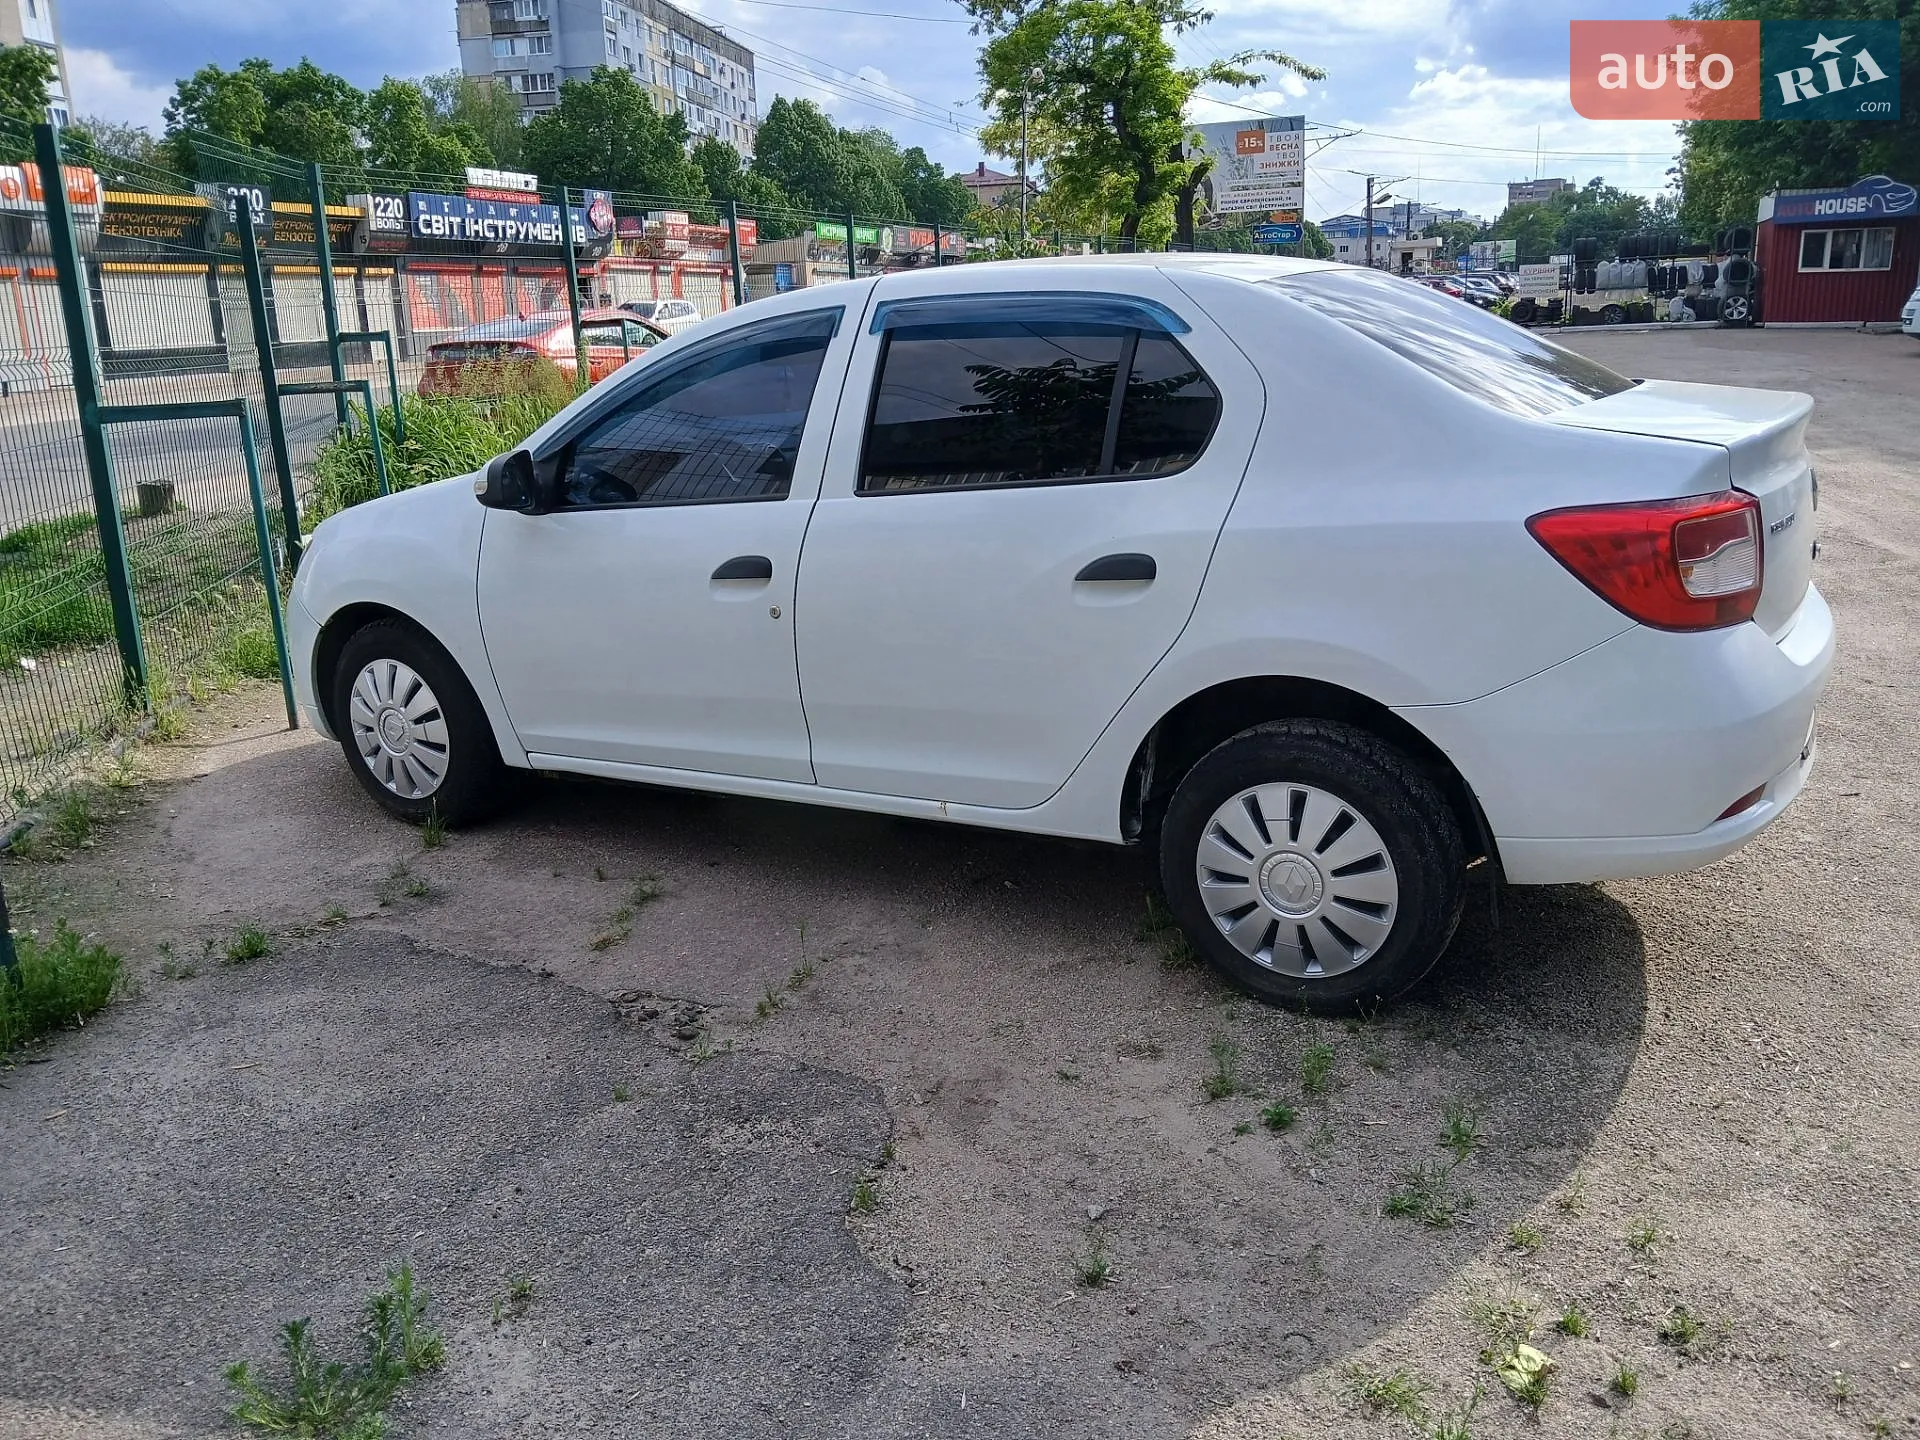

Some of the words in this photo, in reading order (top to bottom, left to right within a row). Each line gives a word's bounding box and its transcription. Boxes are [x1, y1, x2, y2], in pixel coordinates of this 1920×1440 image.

[1269, 133, 1300, 143] ТВОЯ
[1269, 143, 1300, 152] ВЕСНА
[1259, 160, 1300, 169] ЗНИЖКИ
[374, 196, 404, 218] 220
[230, 212, 265, 224] ВЬТ
[377, 218, 406, 231] ВОЛЬТ
[418, 214, 461, 237] СВІТ
[465, 217, 586, 243] ІНСТРУМЕНІВ
[104, 224, 183, 238] БЕНЗОТЕХНІКА
